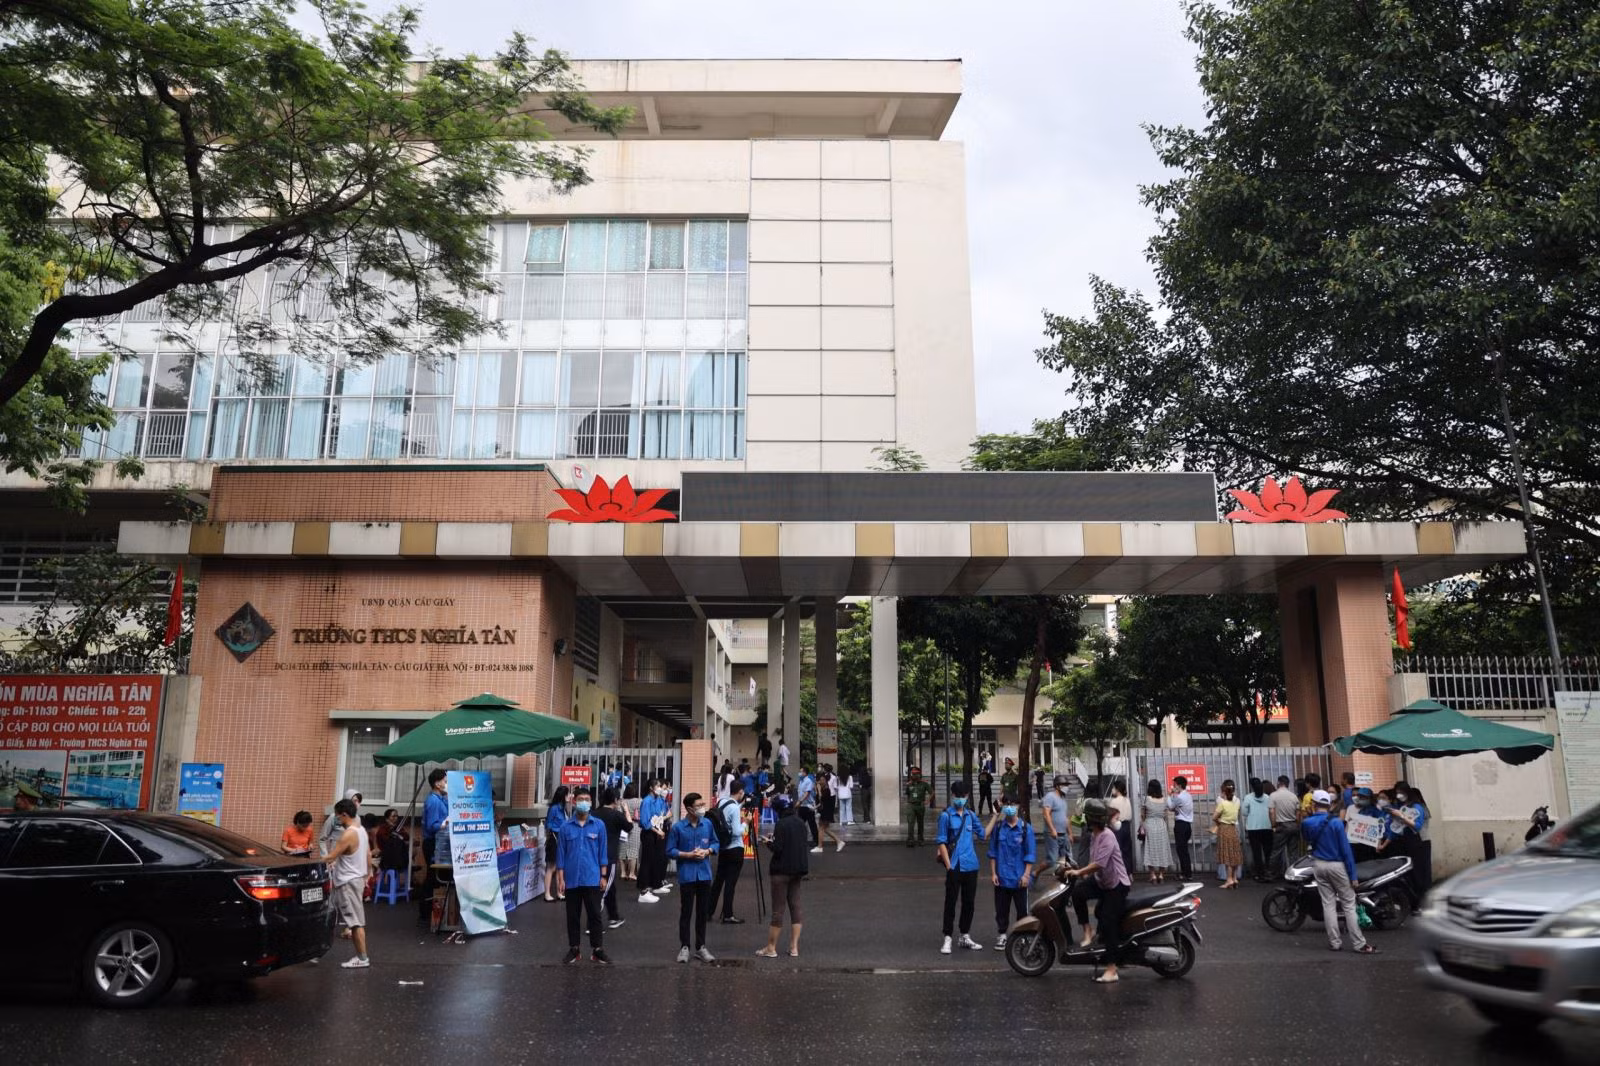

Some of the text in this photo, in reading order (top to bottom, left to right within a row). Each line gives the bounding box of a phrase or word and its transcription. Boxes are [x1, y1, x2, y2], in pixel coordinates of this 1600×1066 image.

[361, 598, 385, 606] UBND
[387, 598, 411, 608] QUẬN
[292, 623, 517, 645] TRƯỜNG THCS NGHĨA TÂN
[340, 661, 368, 671] NGHĨA
[452, 662, 468, 673] NỘI
[501, 663, 517, 673] 3836
[519, 664, 534, 673] 1088
[20, 683, 58, 701] MÙA
[63, 683, 115, 701] NGHĨA
[120, 682, 152, 701] TÂN
[68, 704, 99, 716] Chiều:
[102, 706, 119, 716] 16h
[128, 706, 147, 716] 22h
[7, 719, 29, 735] CẬP
[31, 722, 49, 733] BƠI
[53, 722, 75, 733] CHO
[78, 722, 100, 735] MỌI
[102, 719, 123, 733] LỨA
[126, 716, 151, 733] TUỔI
[445, 725, 496, 734] Vietcombank
[27, 738, 37, 748] Hà
[39, 738, 52, 749] Nội
[60, 738, 86, 749] Trường
[88, 738, 107, 748] THCS
[110, 738, 132, 749] Nghĩa
[134, 738, 148, 748] Tân
